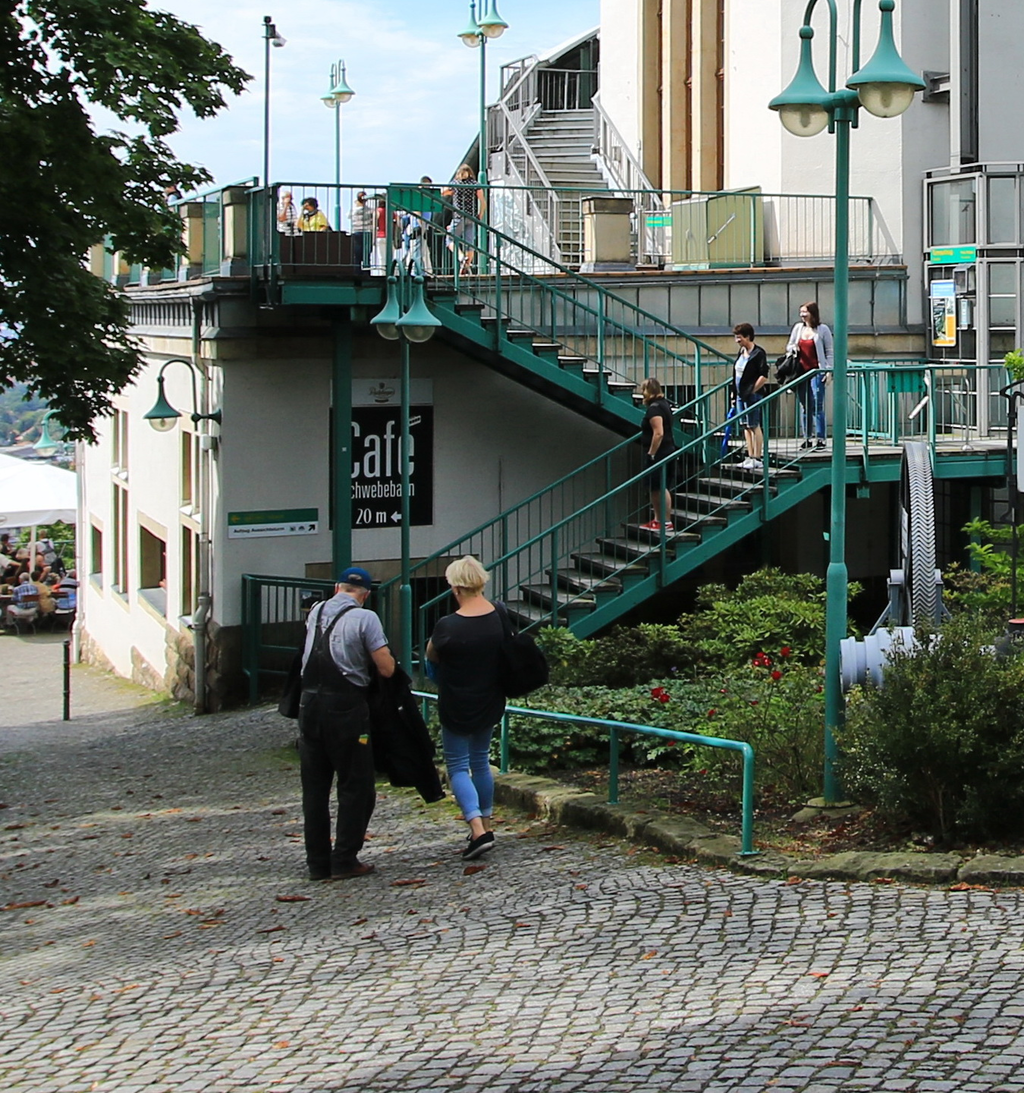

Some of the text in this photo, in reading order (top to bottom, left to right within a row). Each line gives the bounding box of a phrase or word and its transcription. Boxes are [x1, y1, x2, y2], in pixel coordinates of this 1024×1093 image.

[351, 480, 415, 499] chwebeban
[355, 508, 387, 525] 20 m
